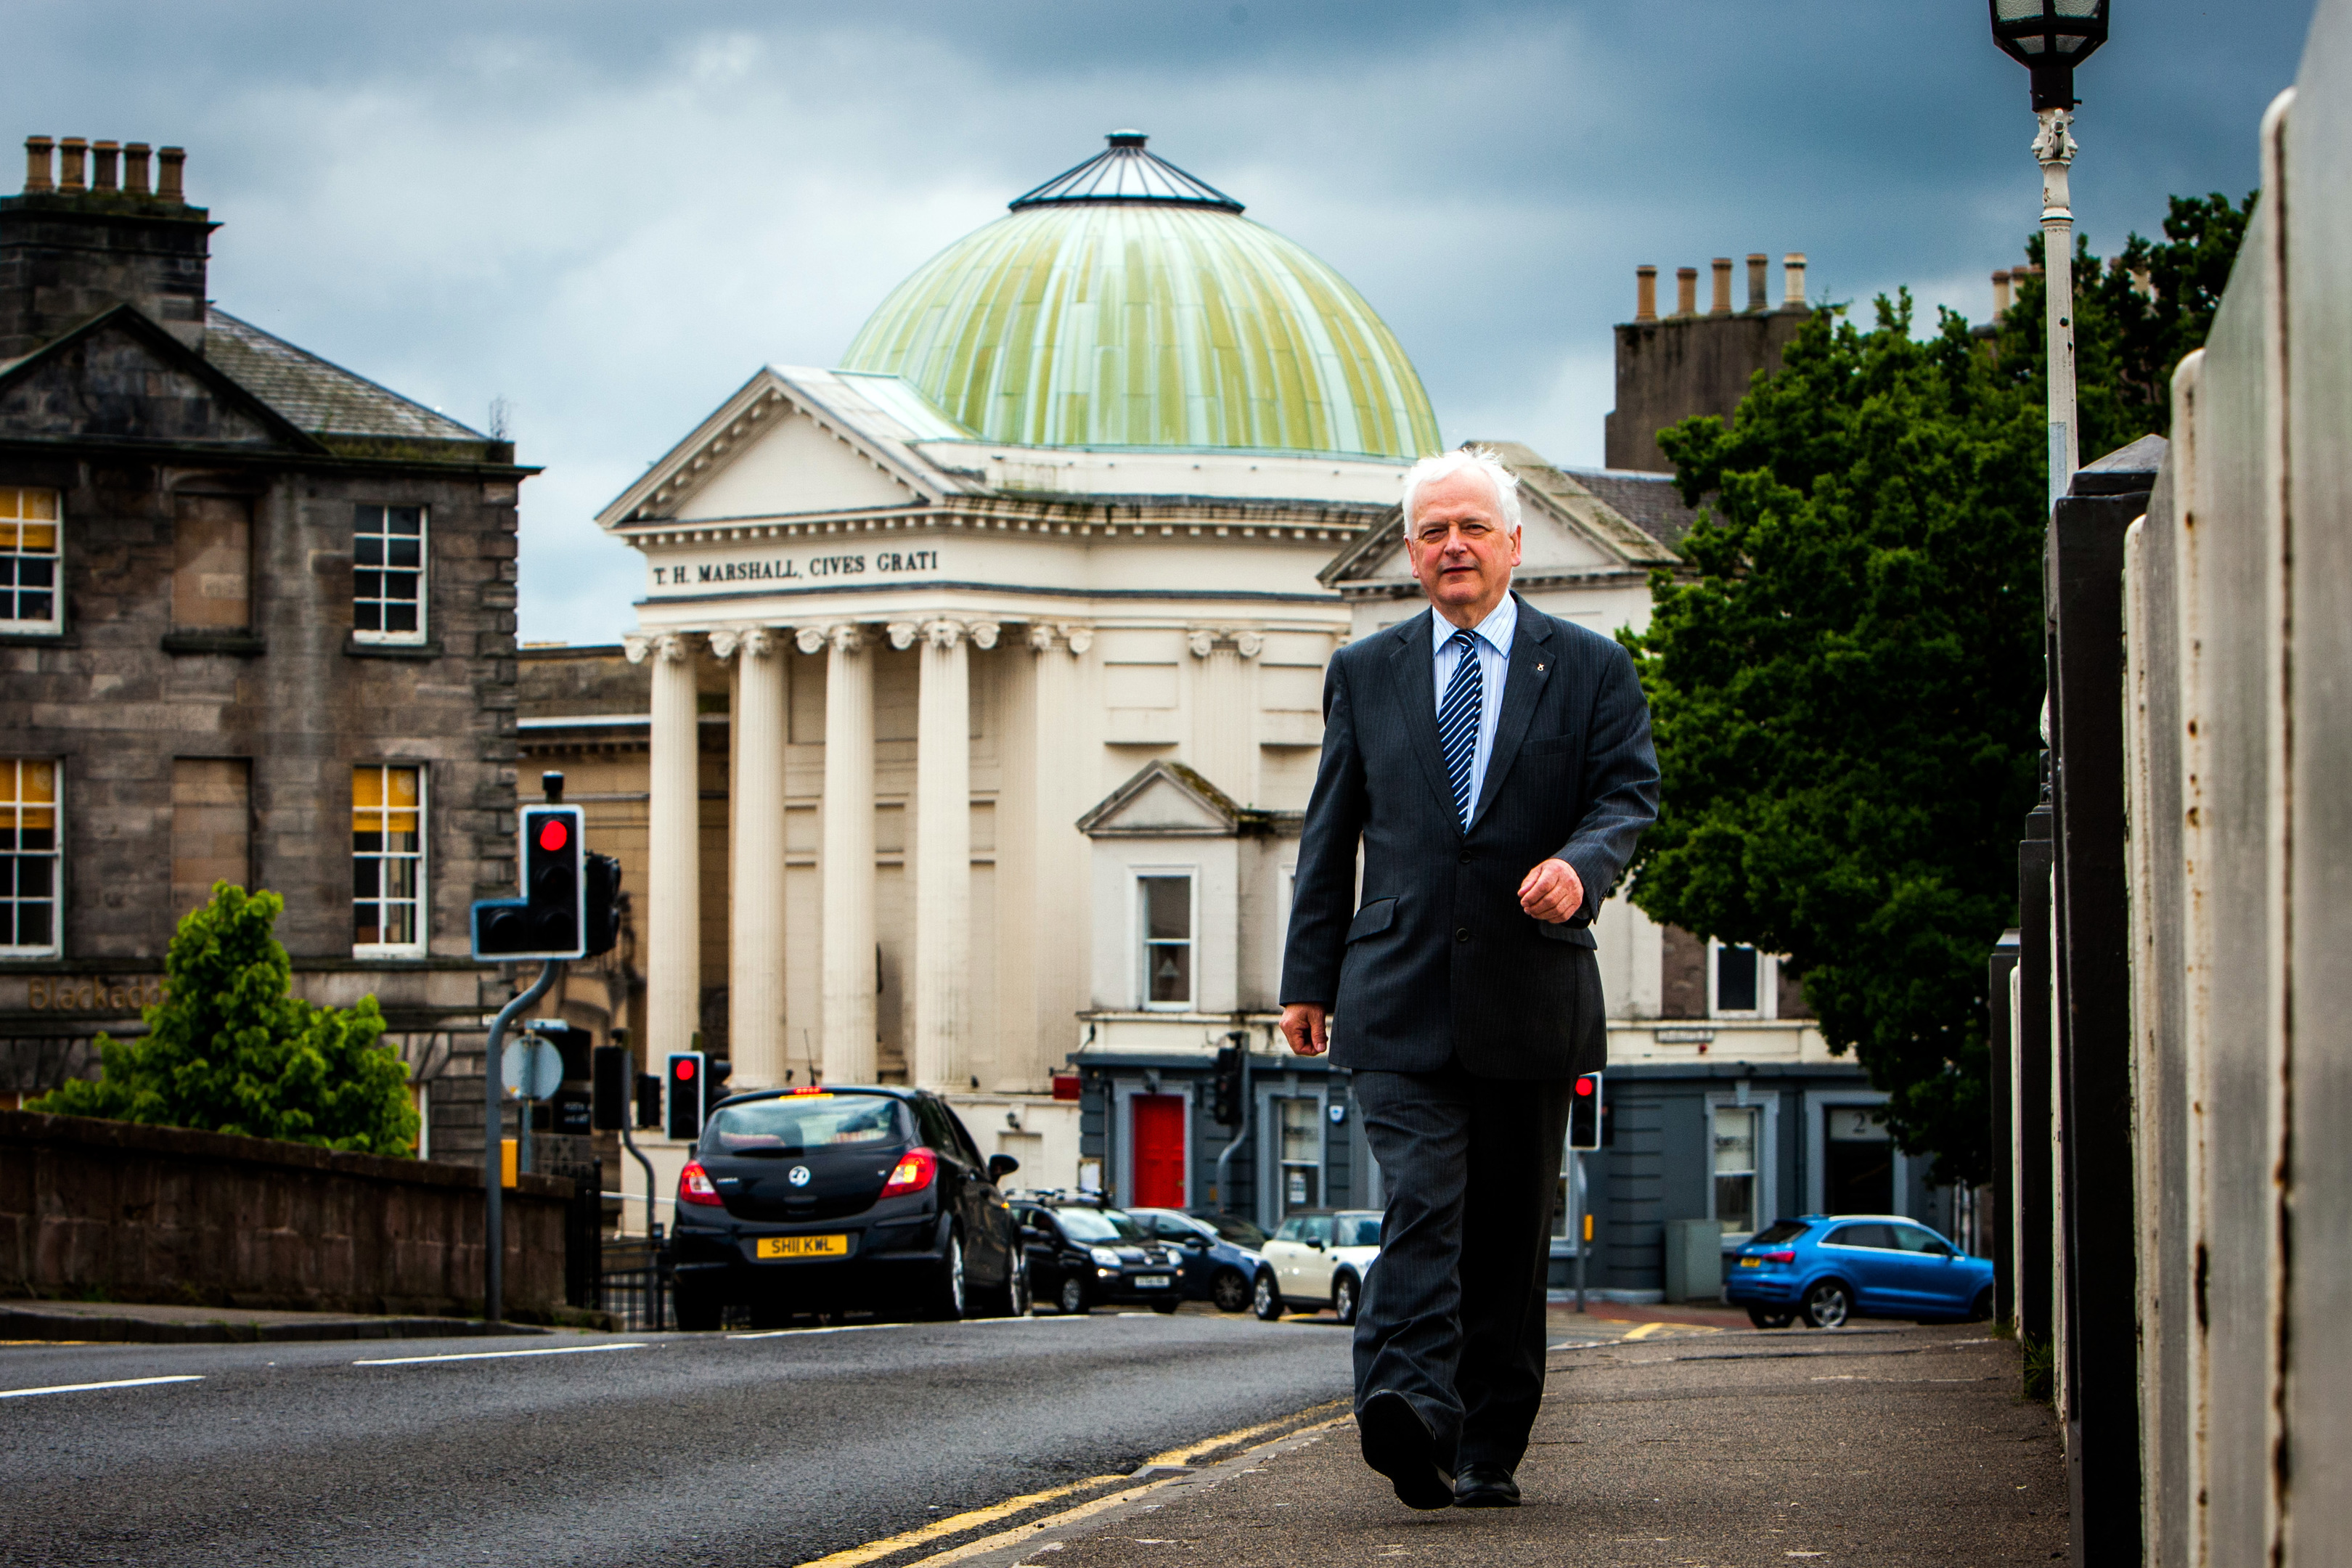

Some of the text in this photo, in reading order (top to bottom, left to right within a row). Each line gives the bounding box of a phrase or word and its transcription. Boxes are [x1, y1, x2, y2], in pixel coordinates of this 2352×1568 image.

[809, 555, 865, 576] CIVES
[877, 550, 938, 571] GRATI
[29, 975, 168, 1010] Blackadd
[1853, 1112, 1866, 1132] 2
[804, 1236, 834, 1252] KWL
